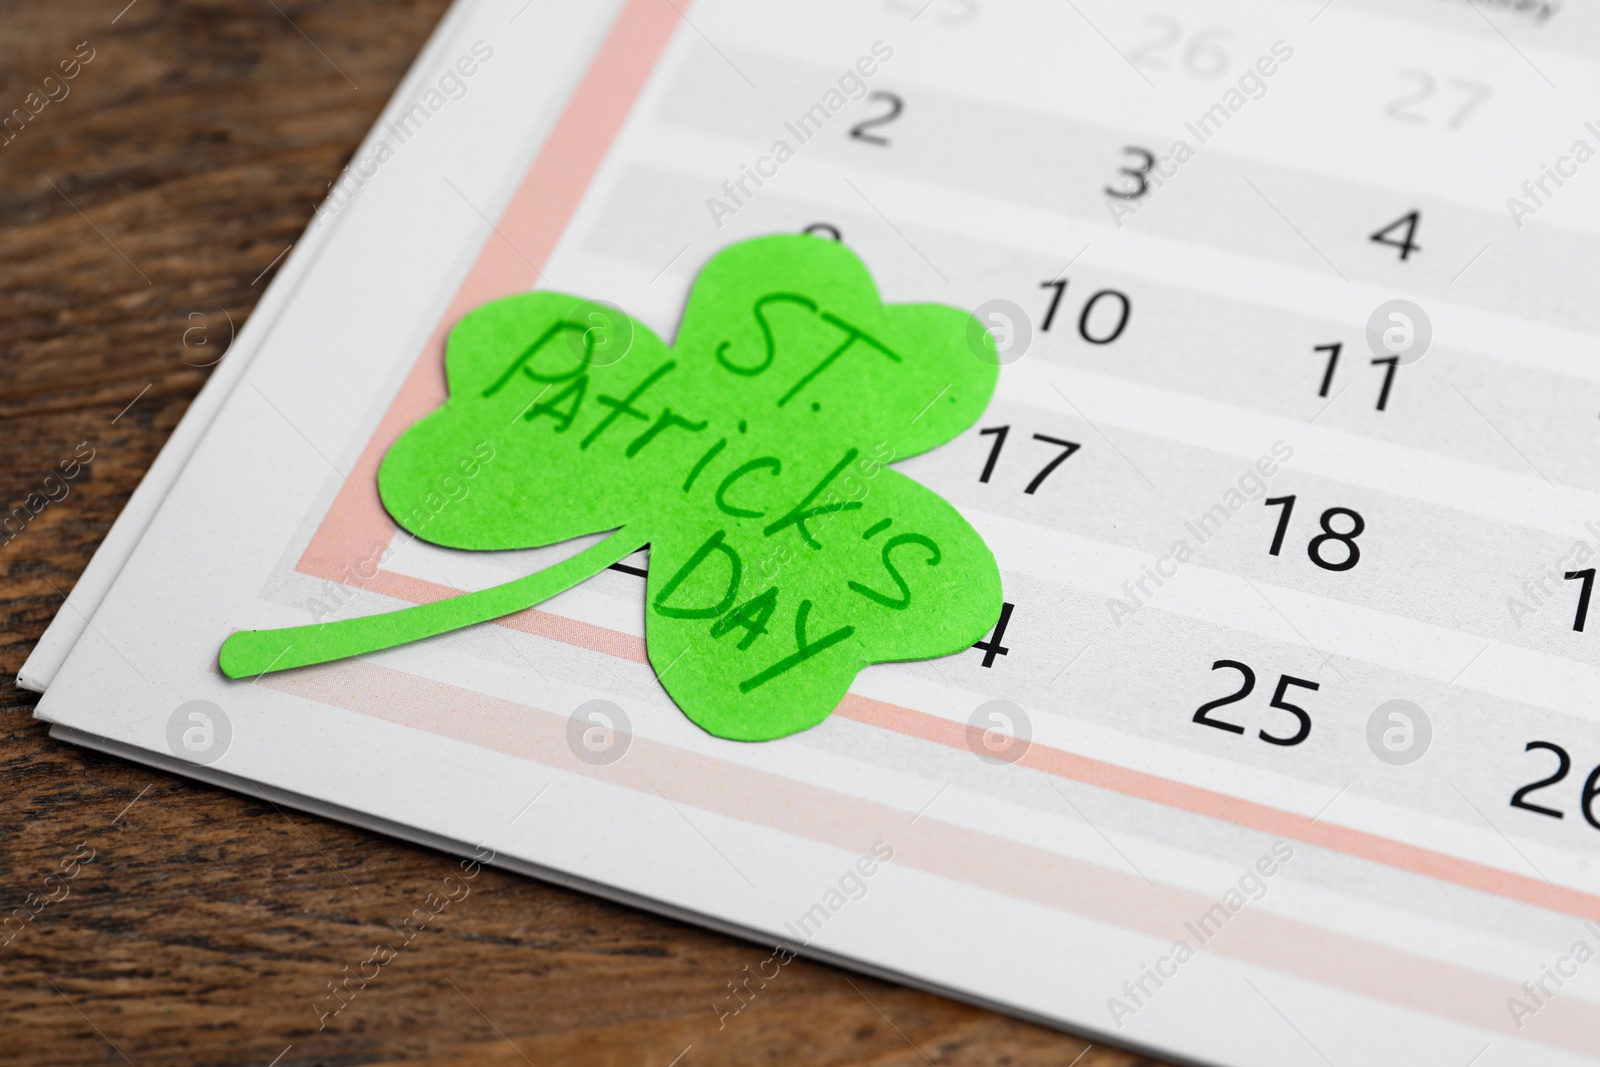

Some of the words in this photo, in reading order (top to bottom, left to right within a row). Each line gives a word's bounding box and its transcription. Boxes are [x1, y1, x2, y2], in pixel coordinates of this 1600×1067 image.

[1131, 13, 1237, 81] 26
[848, 90, 905, 147] 2
[1385, 67, 1494, 131] 27
[1104, 145, 1157, 200] 3
[1369, 209, 1422, 262] 4
[1038, 277, 1132, 345] 10
[1313, 342, 1400, 412] 11
[978, 425, 1081, 495] 17
[1265, 494, 1366, 572] 18
[653, 529, 855, 693] DAY
[1564, 567, 1596, 632] 1
[971, 602, 1015, 669] 4
[1192, 659, 1321, 747] 25
